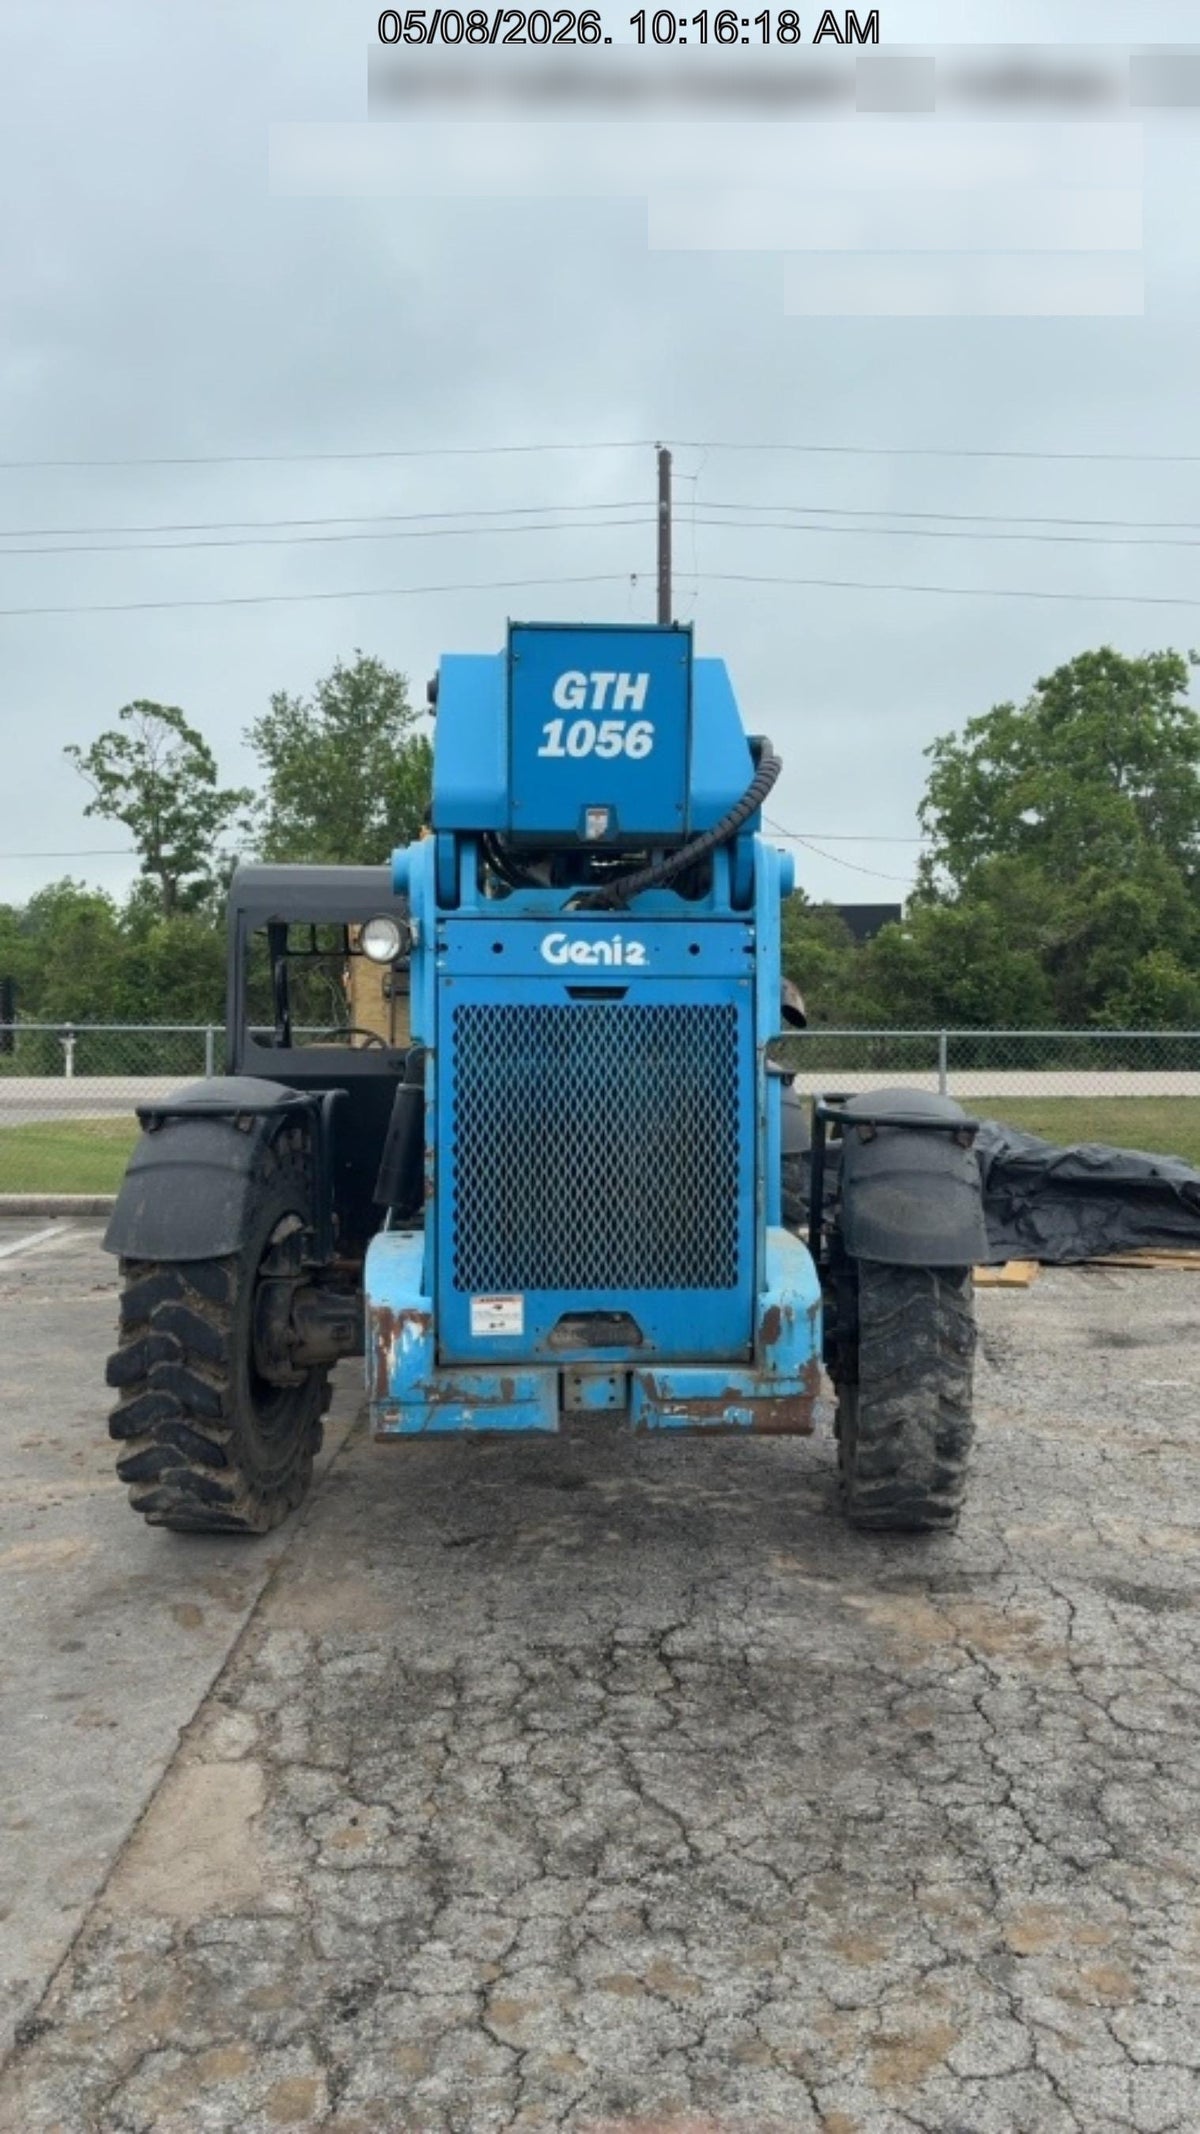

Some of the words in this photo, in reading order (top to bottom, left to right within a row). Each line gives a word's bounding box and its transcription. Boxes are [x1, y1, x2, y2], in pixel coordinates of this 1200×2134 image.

[552, 670, 650, 711] GTH
[537, 718, 654, 759] 1056
[540, 932, 646, 966] Genie
